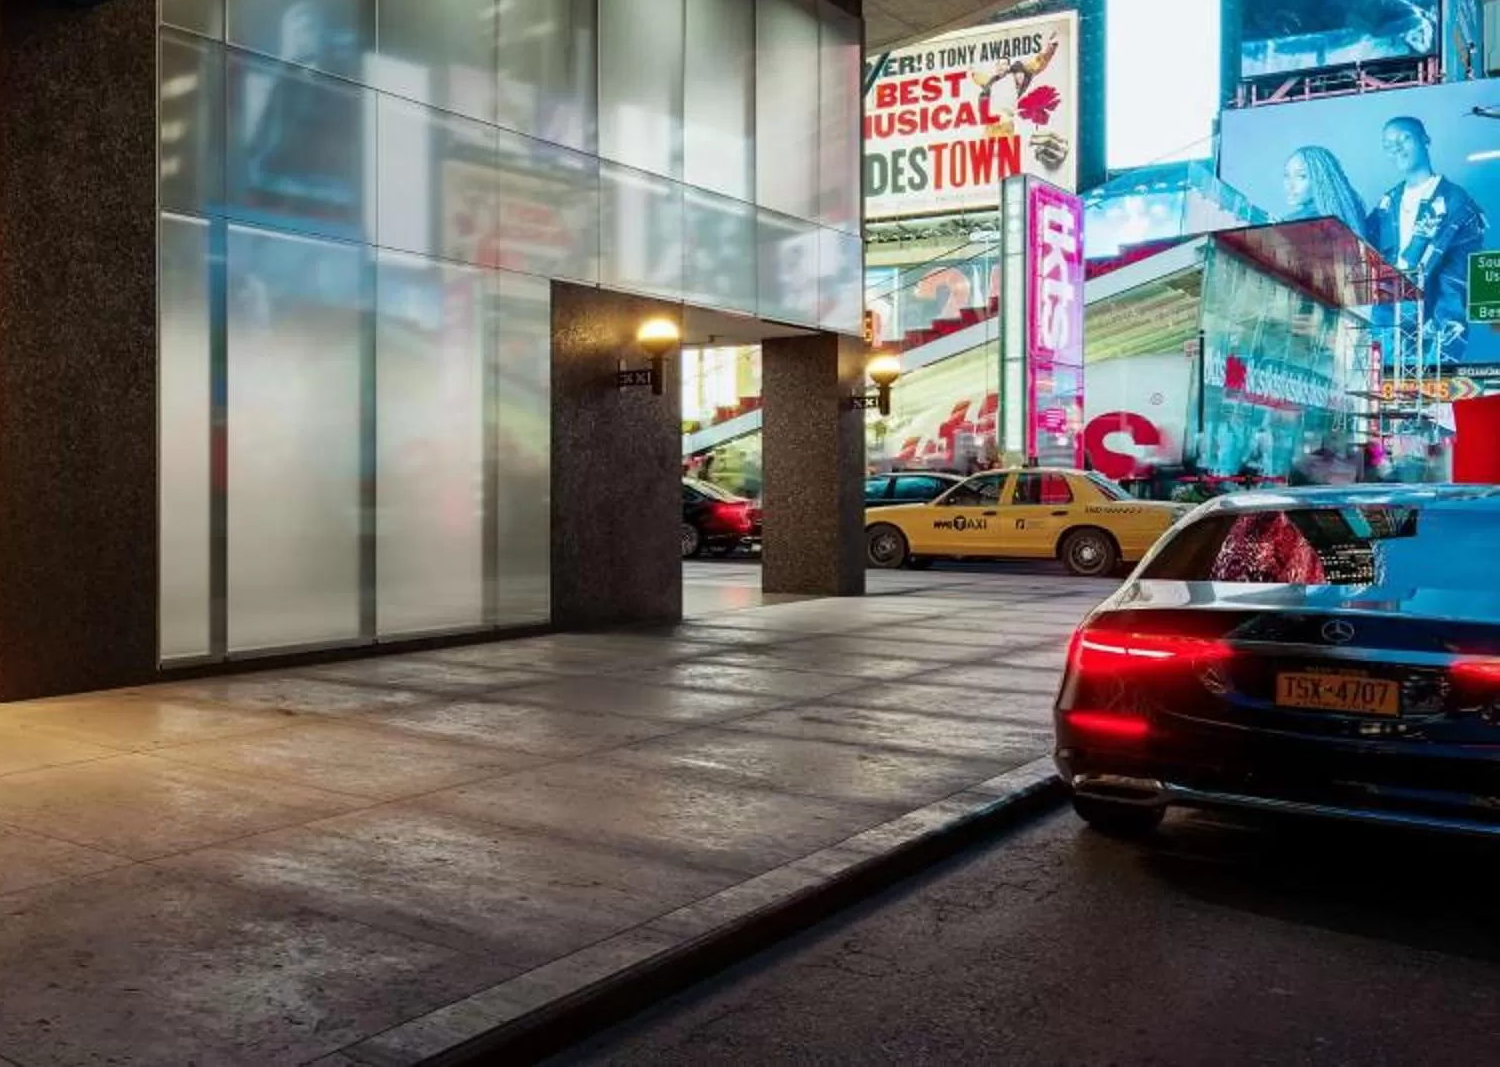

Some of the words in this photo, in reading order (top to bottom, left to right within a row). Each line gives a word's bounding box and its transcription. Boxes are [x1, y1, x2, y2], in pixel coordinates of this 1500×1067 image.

[925, 51, 935, 70] 8
[938, 43, 977, 68] TONY
[980, 33, 1043, 62] AWARDS
[876, 71, 967, 109] BEST
